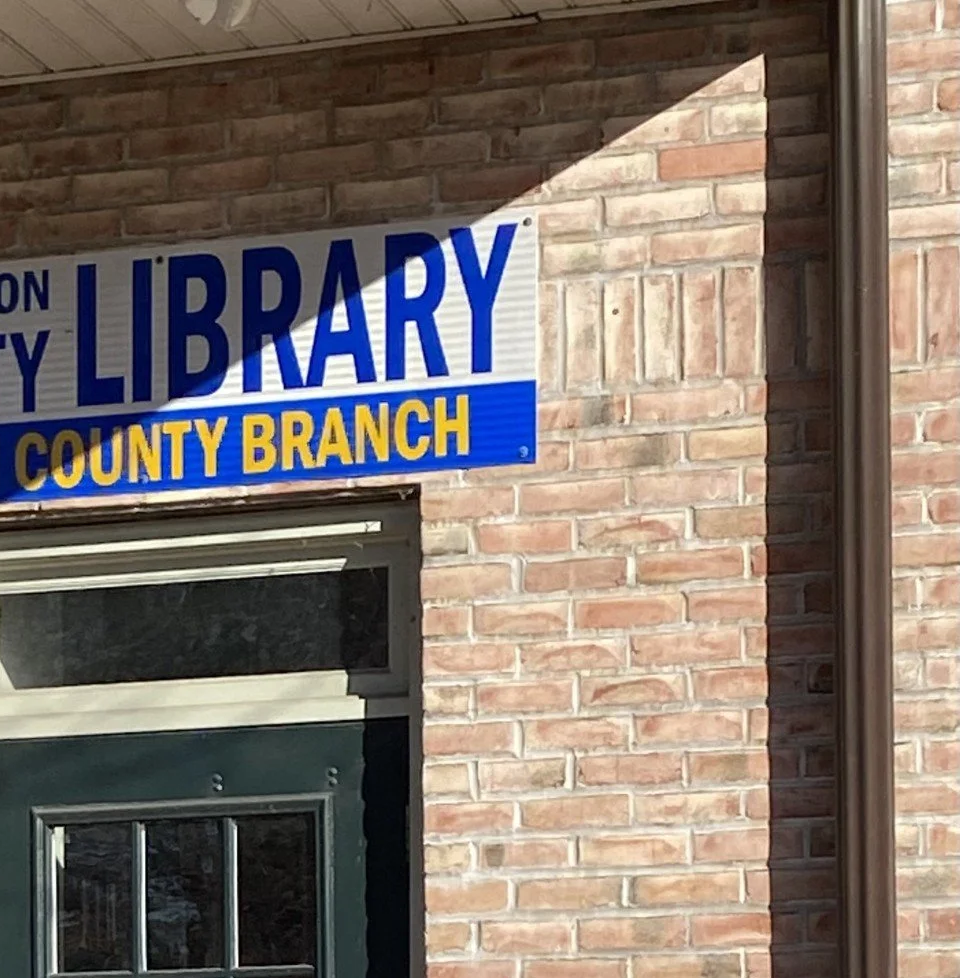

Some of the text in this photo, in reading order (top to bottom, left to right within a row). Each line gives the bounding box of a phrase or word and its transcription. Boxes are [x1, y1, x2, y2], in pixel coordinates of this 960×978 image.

[76, 224, 517, 406] LIBRARY
[16, 419, 227, 490] COUNTY
[242, 395, 470, 474] BRANCH
